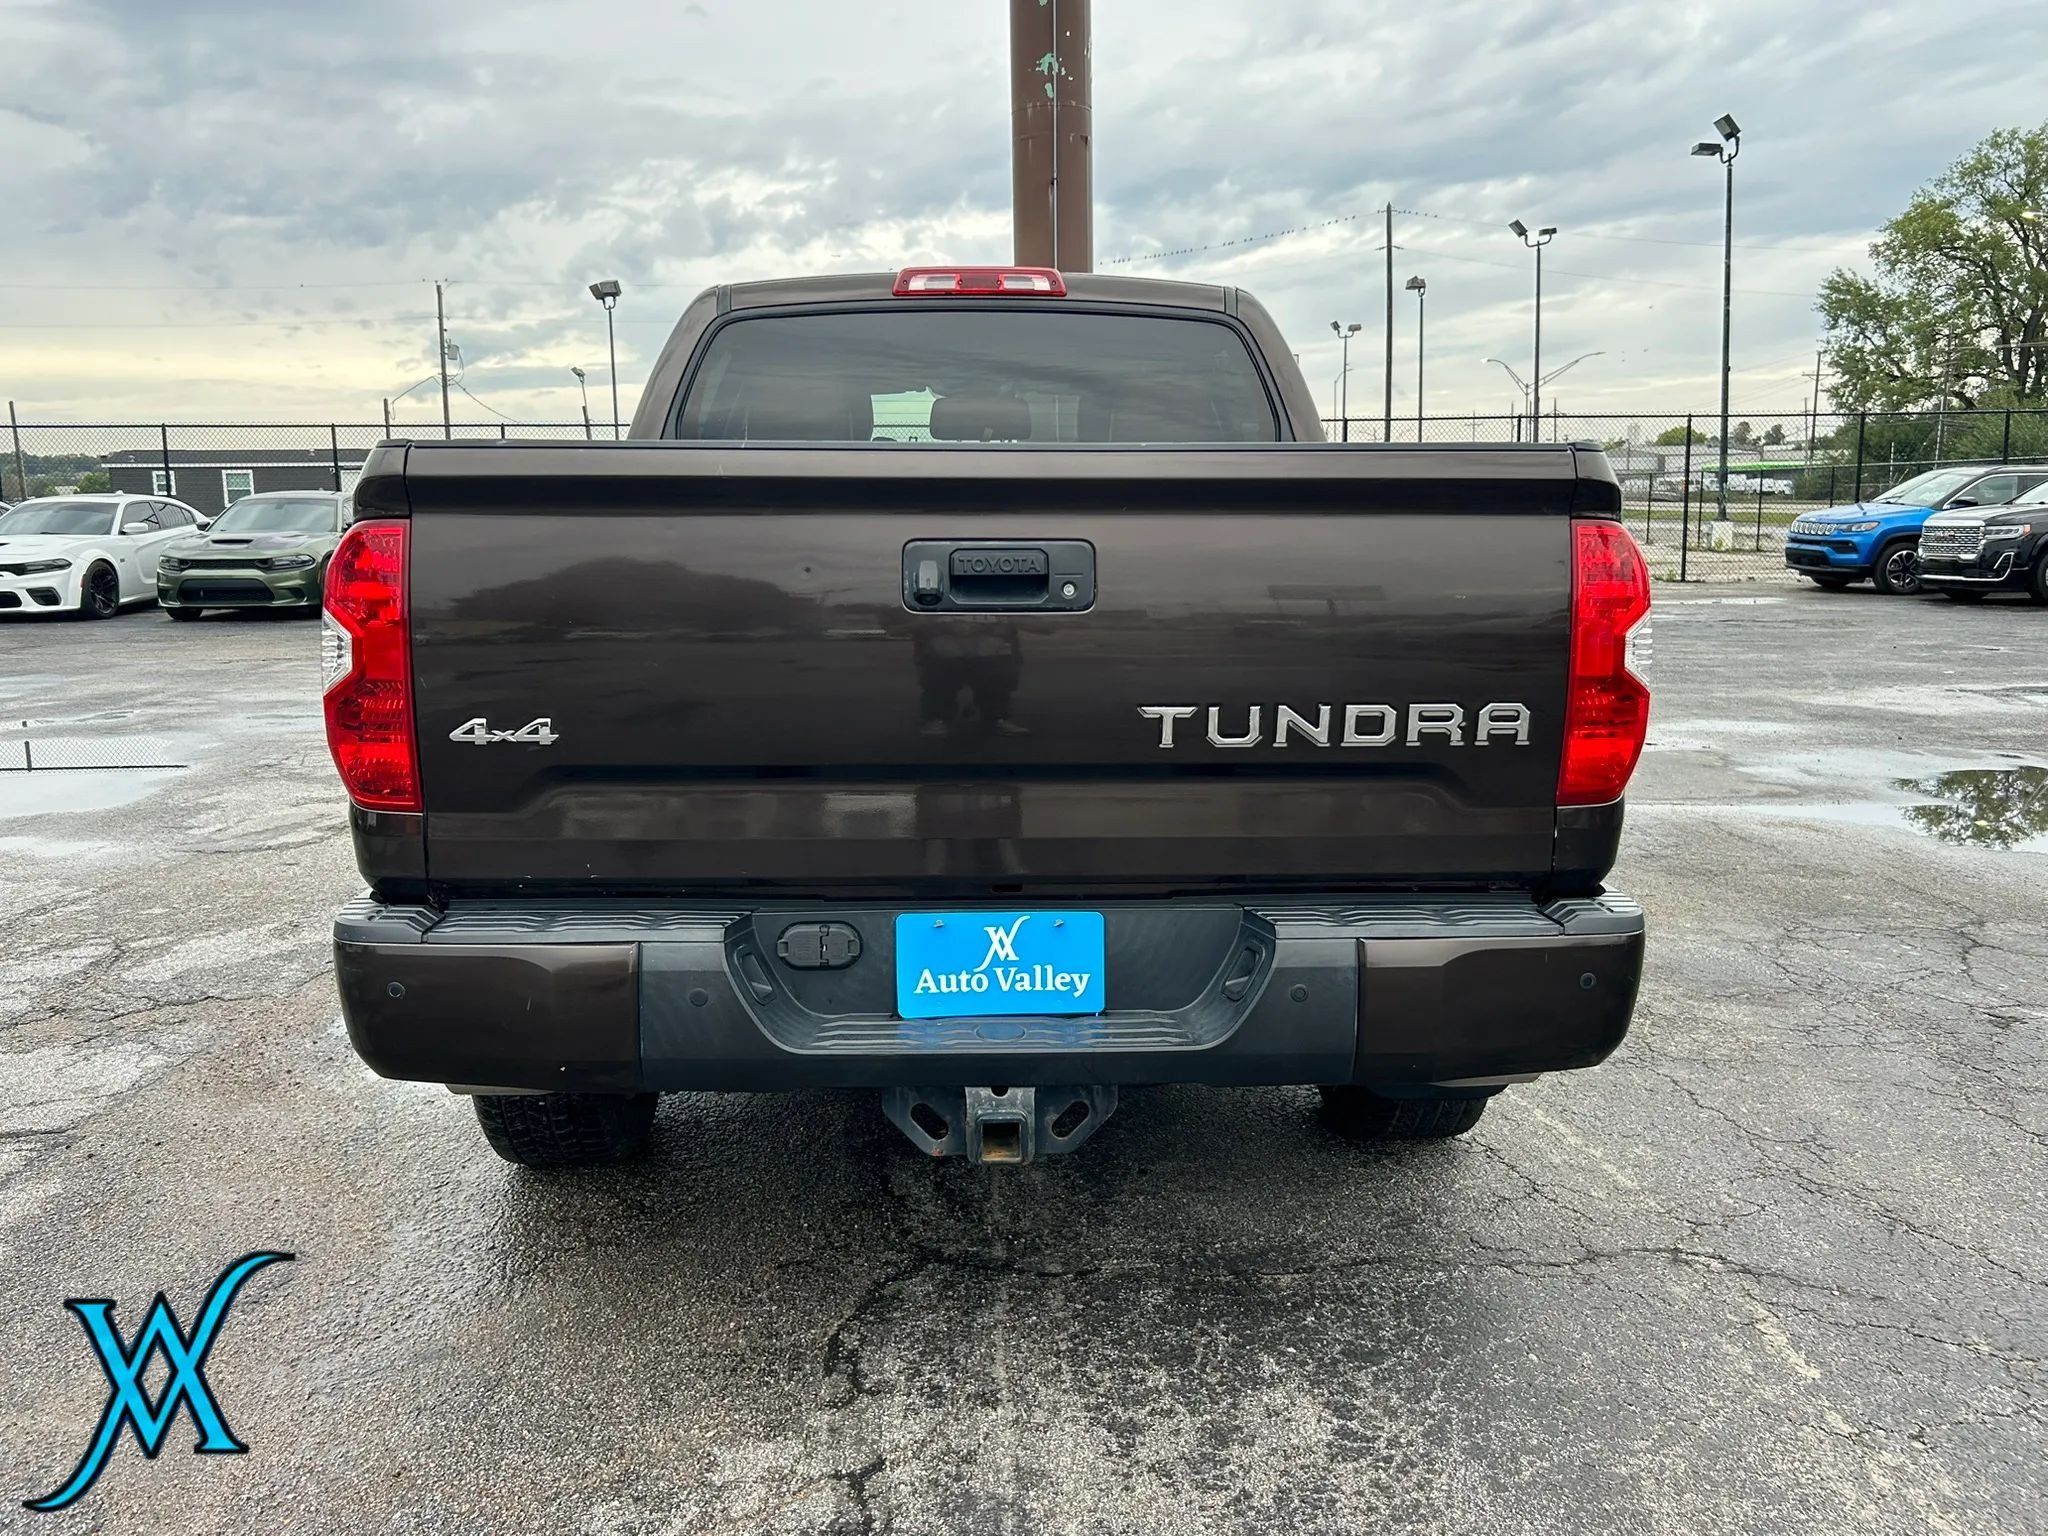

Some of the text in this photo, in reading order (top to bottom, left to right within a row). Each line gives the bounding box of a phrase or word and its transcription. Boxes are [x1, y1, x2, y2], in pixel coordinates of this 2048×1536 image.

[958, 556, 1040, 573] TOYOTA
[448, 718, 560, 745] 4x4
[1137, 702, 1531, 748] TUNDRA
[913, 964, 1091, 999] Auto Valley
